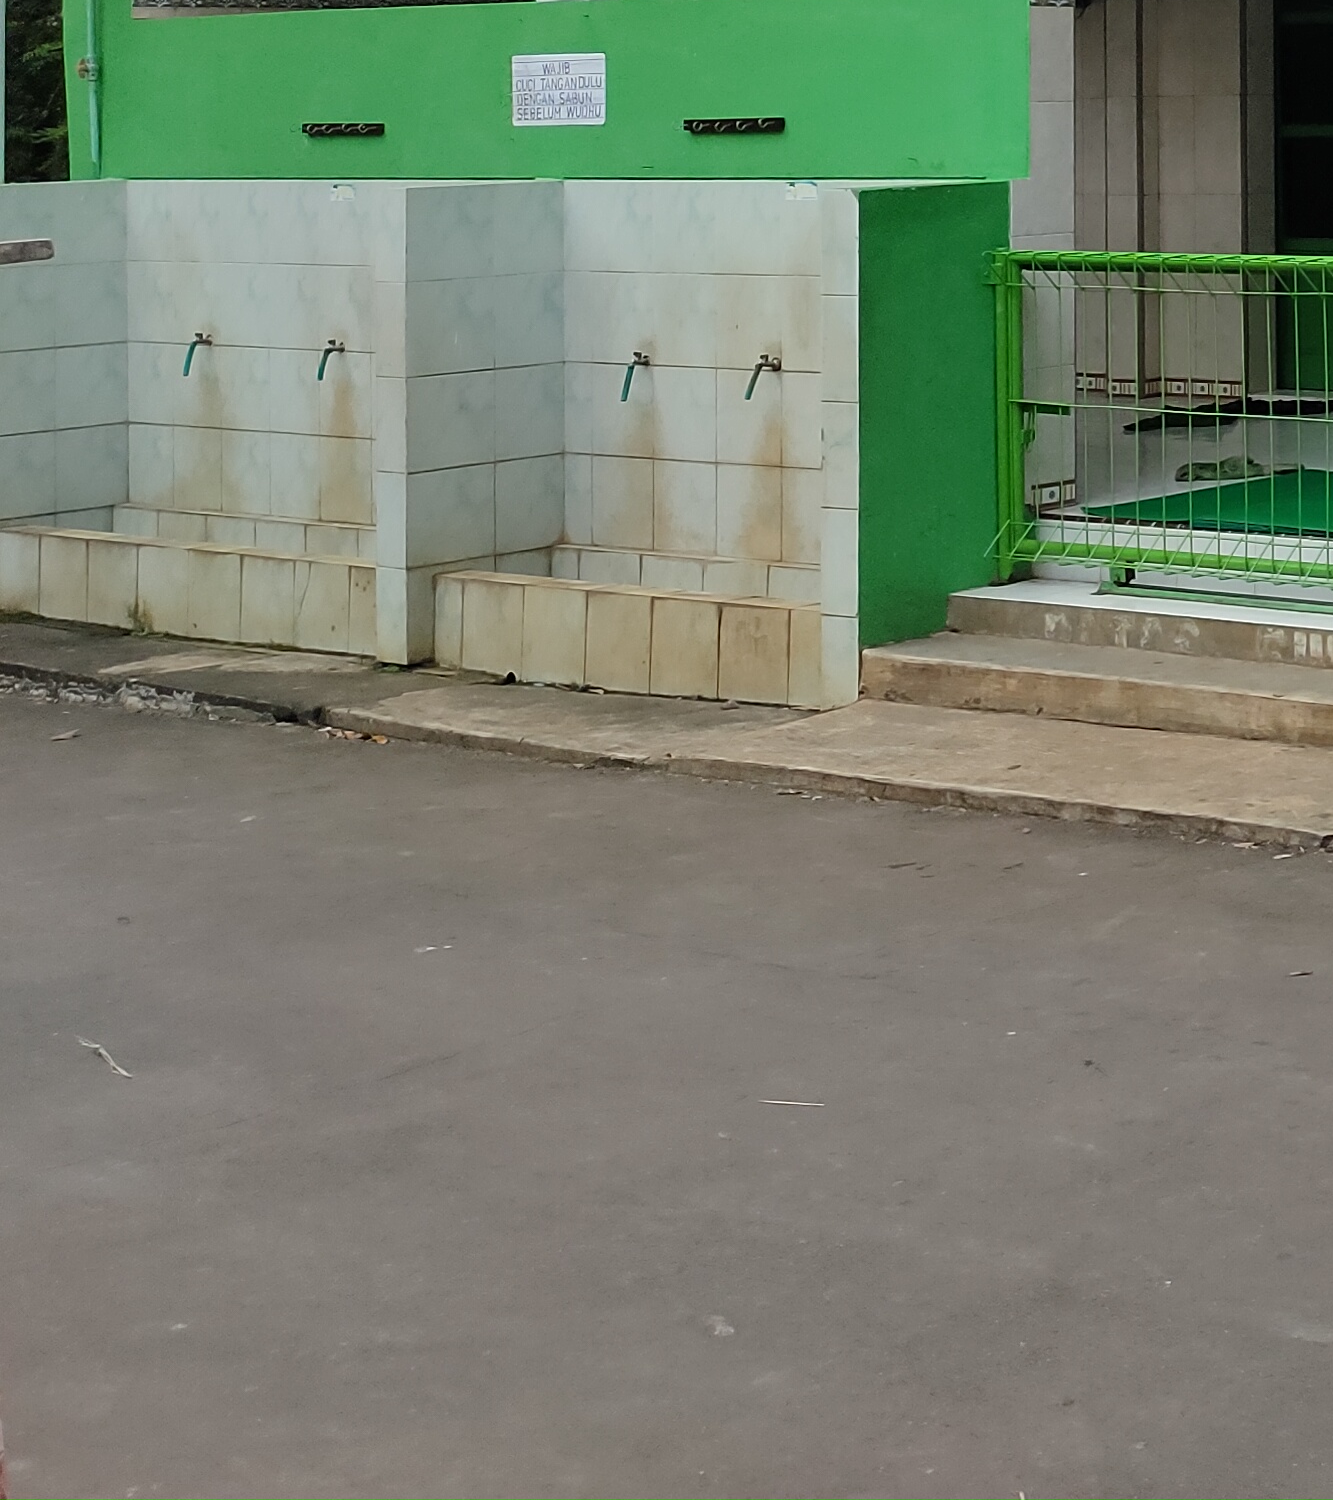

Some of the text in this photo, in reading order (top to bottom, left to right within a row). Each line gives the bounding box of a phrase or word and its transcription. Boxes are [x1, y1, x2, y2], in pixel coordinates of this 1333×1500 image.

[542, 62, 570, 74] WAJIB
[516, 76, 602, 91] CUCI TANGAN DULU
[517, 92, 593, 106] DENGAN SABUN
[517, 106, 601, 120] SEBELUM WUDHU
